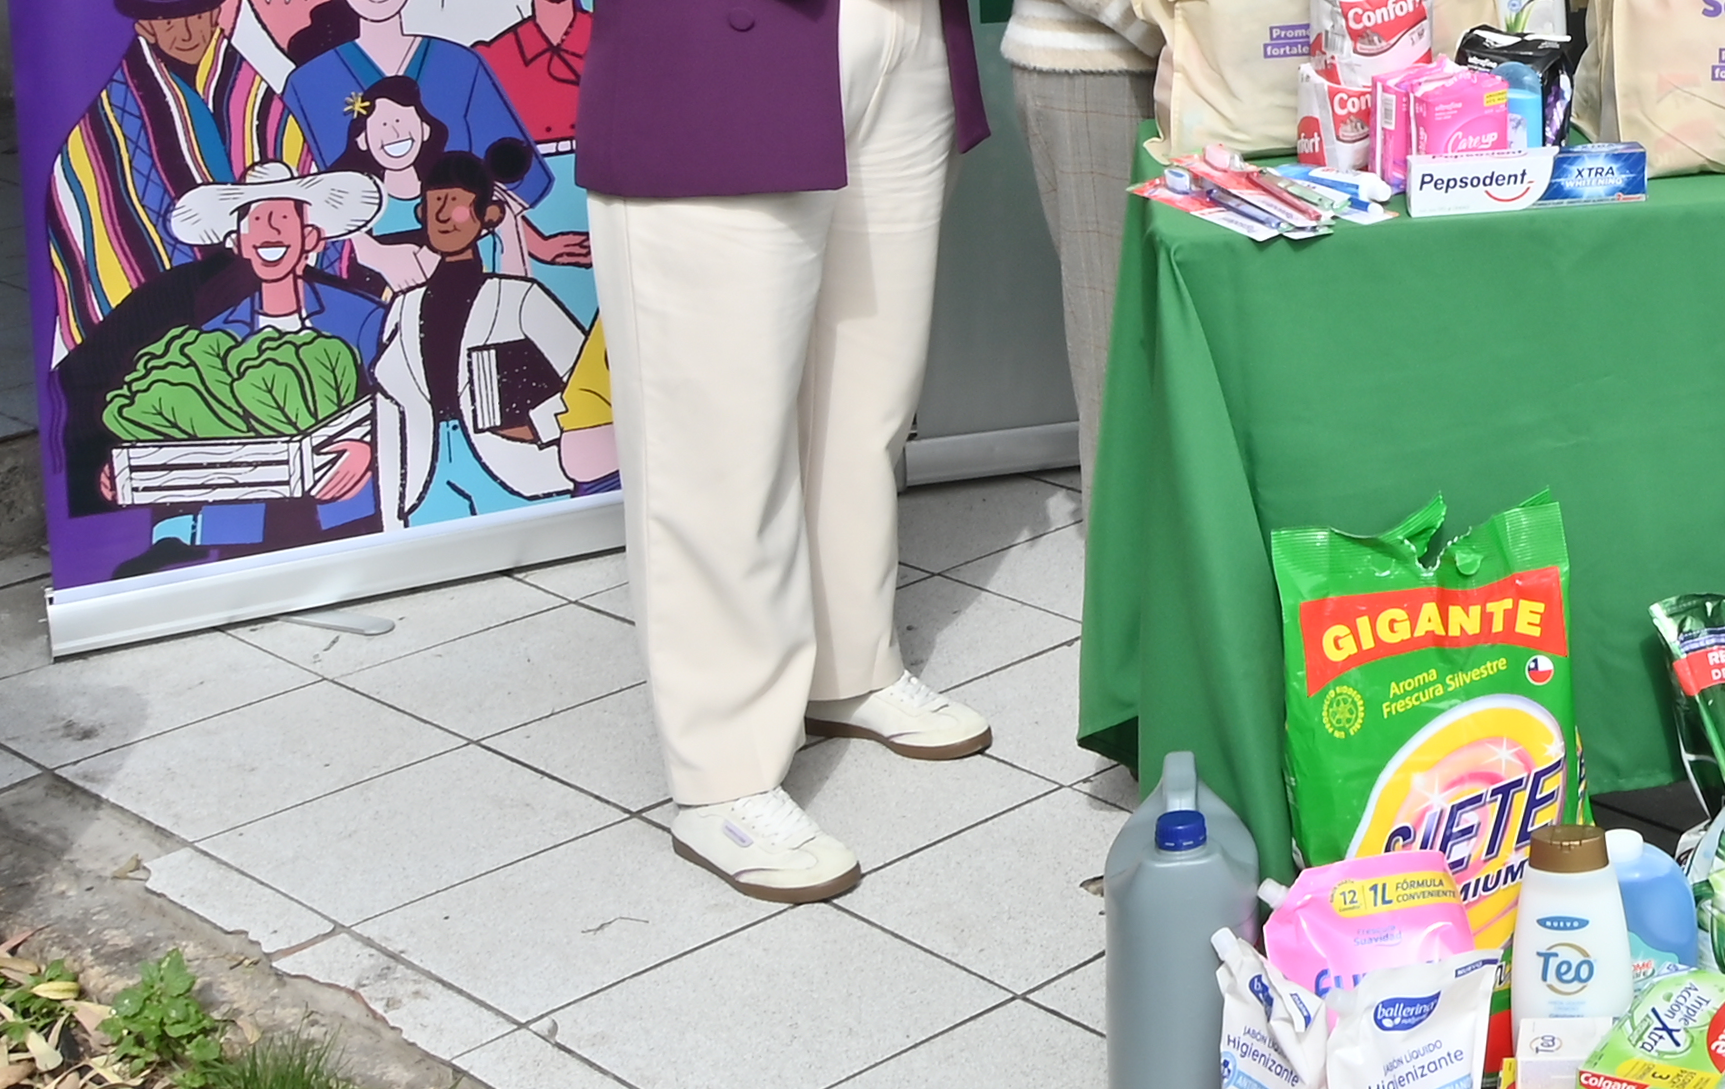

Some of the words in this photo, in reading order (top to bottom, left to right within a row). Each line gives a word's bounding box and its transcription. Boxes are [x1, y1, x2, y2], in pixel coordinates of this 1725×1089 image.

[1418, 168, 1528, 194] Pepsodent
[1565, 176, 1623, 188] WHITENING
[1575, 165, 1616, 178] XTRA
[1321, 598, 1546, 662] GIGANTE
[1382, 682, 1445, 719] Frescura
[1444, 657, 1508, 692] Silvestre
[1389, 668, 1438, 699] Aroma
[1339, 889, 1358, 906] 12
[1369, 882, 1394, 908] 1L
[1395, 877, 1445, 892] FÓRMULA
[1395, 889, 1456, 904] CONVENIENTE
[1545, 920, 1579, 928] NUEVO
[1353, 930, 1402, 948] Suavidad
[1535, 951, 1595, 984] Teo
[1678, 991, 1713, 1027] Triple
[1535, 1034, 1556, 1054] Teo
[1639, 1006, 1683, 1054] Xtra
[1226, 1034, 1300, 1088] Higienizante
[1404, 1039, 1443, 1064] LÍQUIDO
